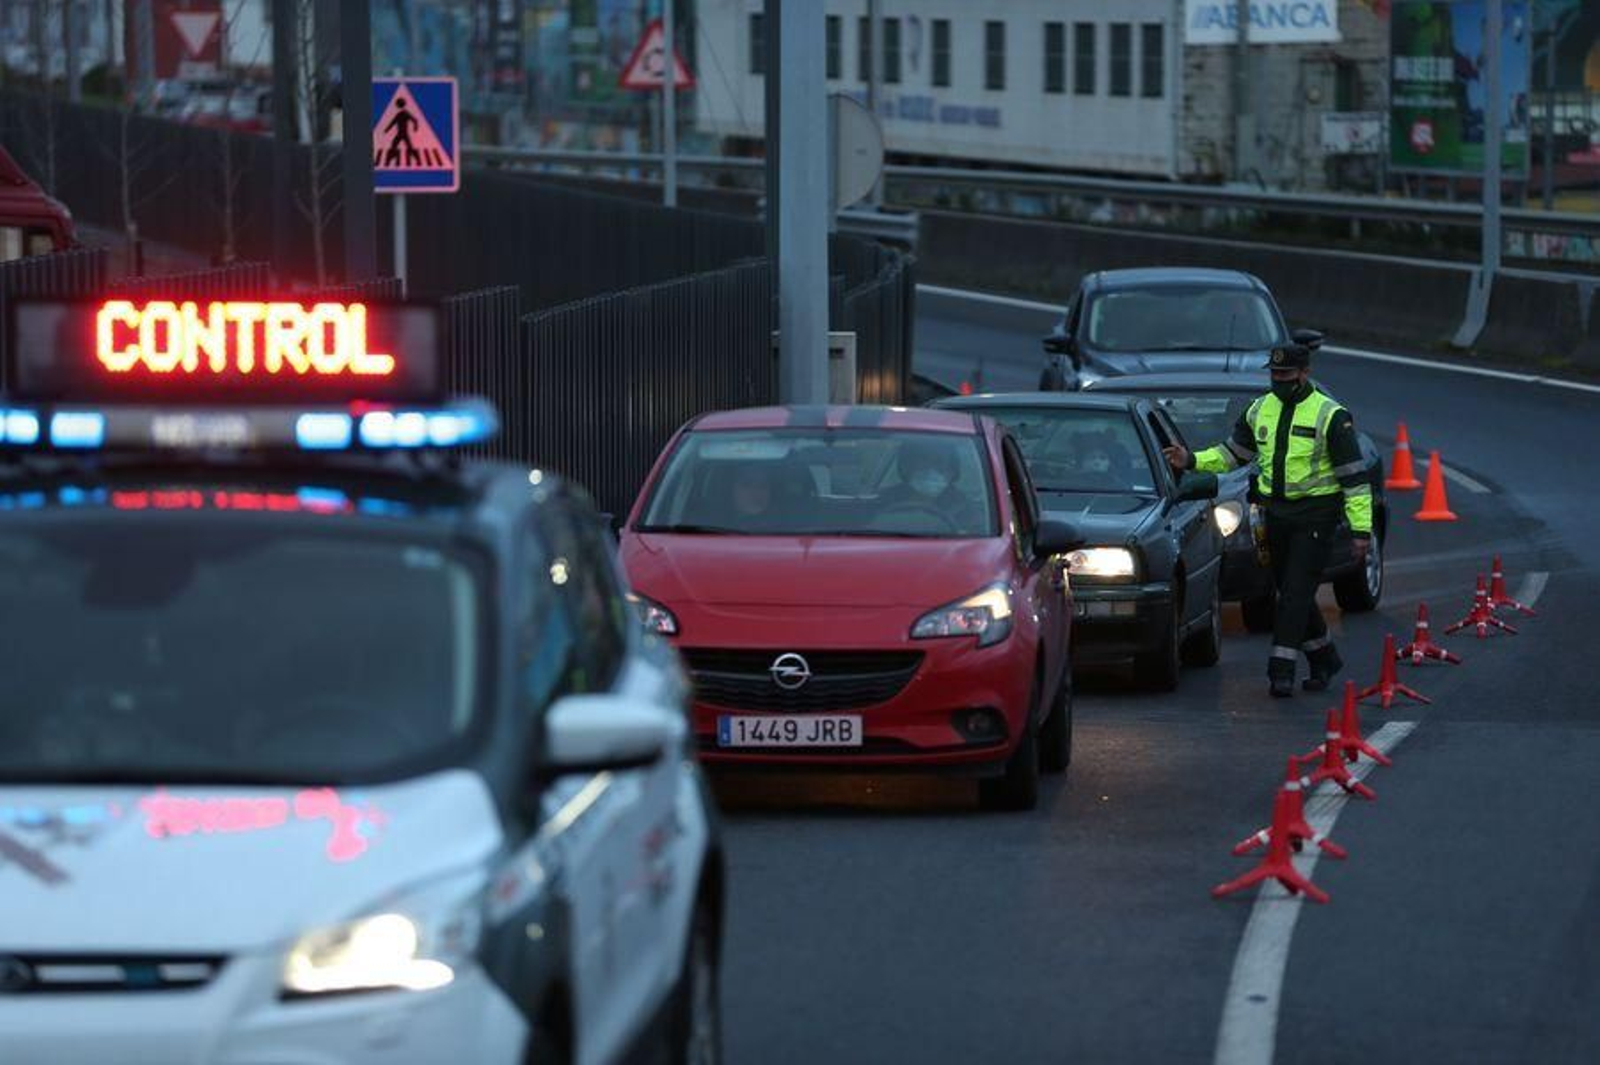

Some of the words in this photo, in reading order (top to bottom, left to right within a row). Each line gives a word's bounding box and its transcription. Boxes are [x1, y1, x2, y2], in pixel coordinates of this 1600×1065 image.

[1192, 3, 1330, 29] ABANCA
[97, 301, 395, 373] CONTROL
[738, 719, 798, 742] 1449
[806, 719, 853, 742] JRB
